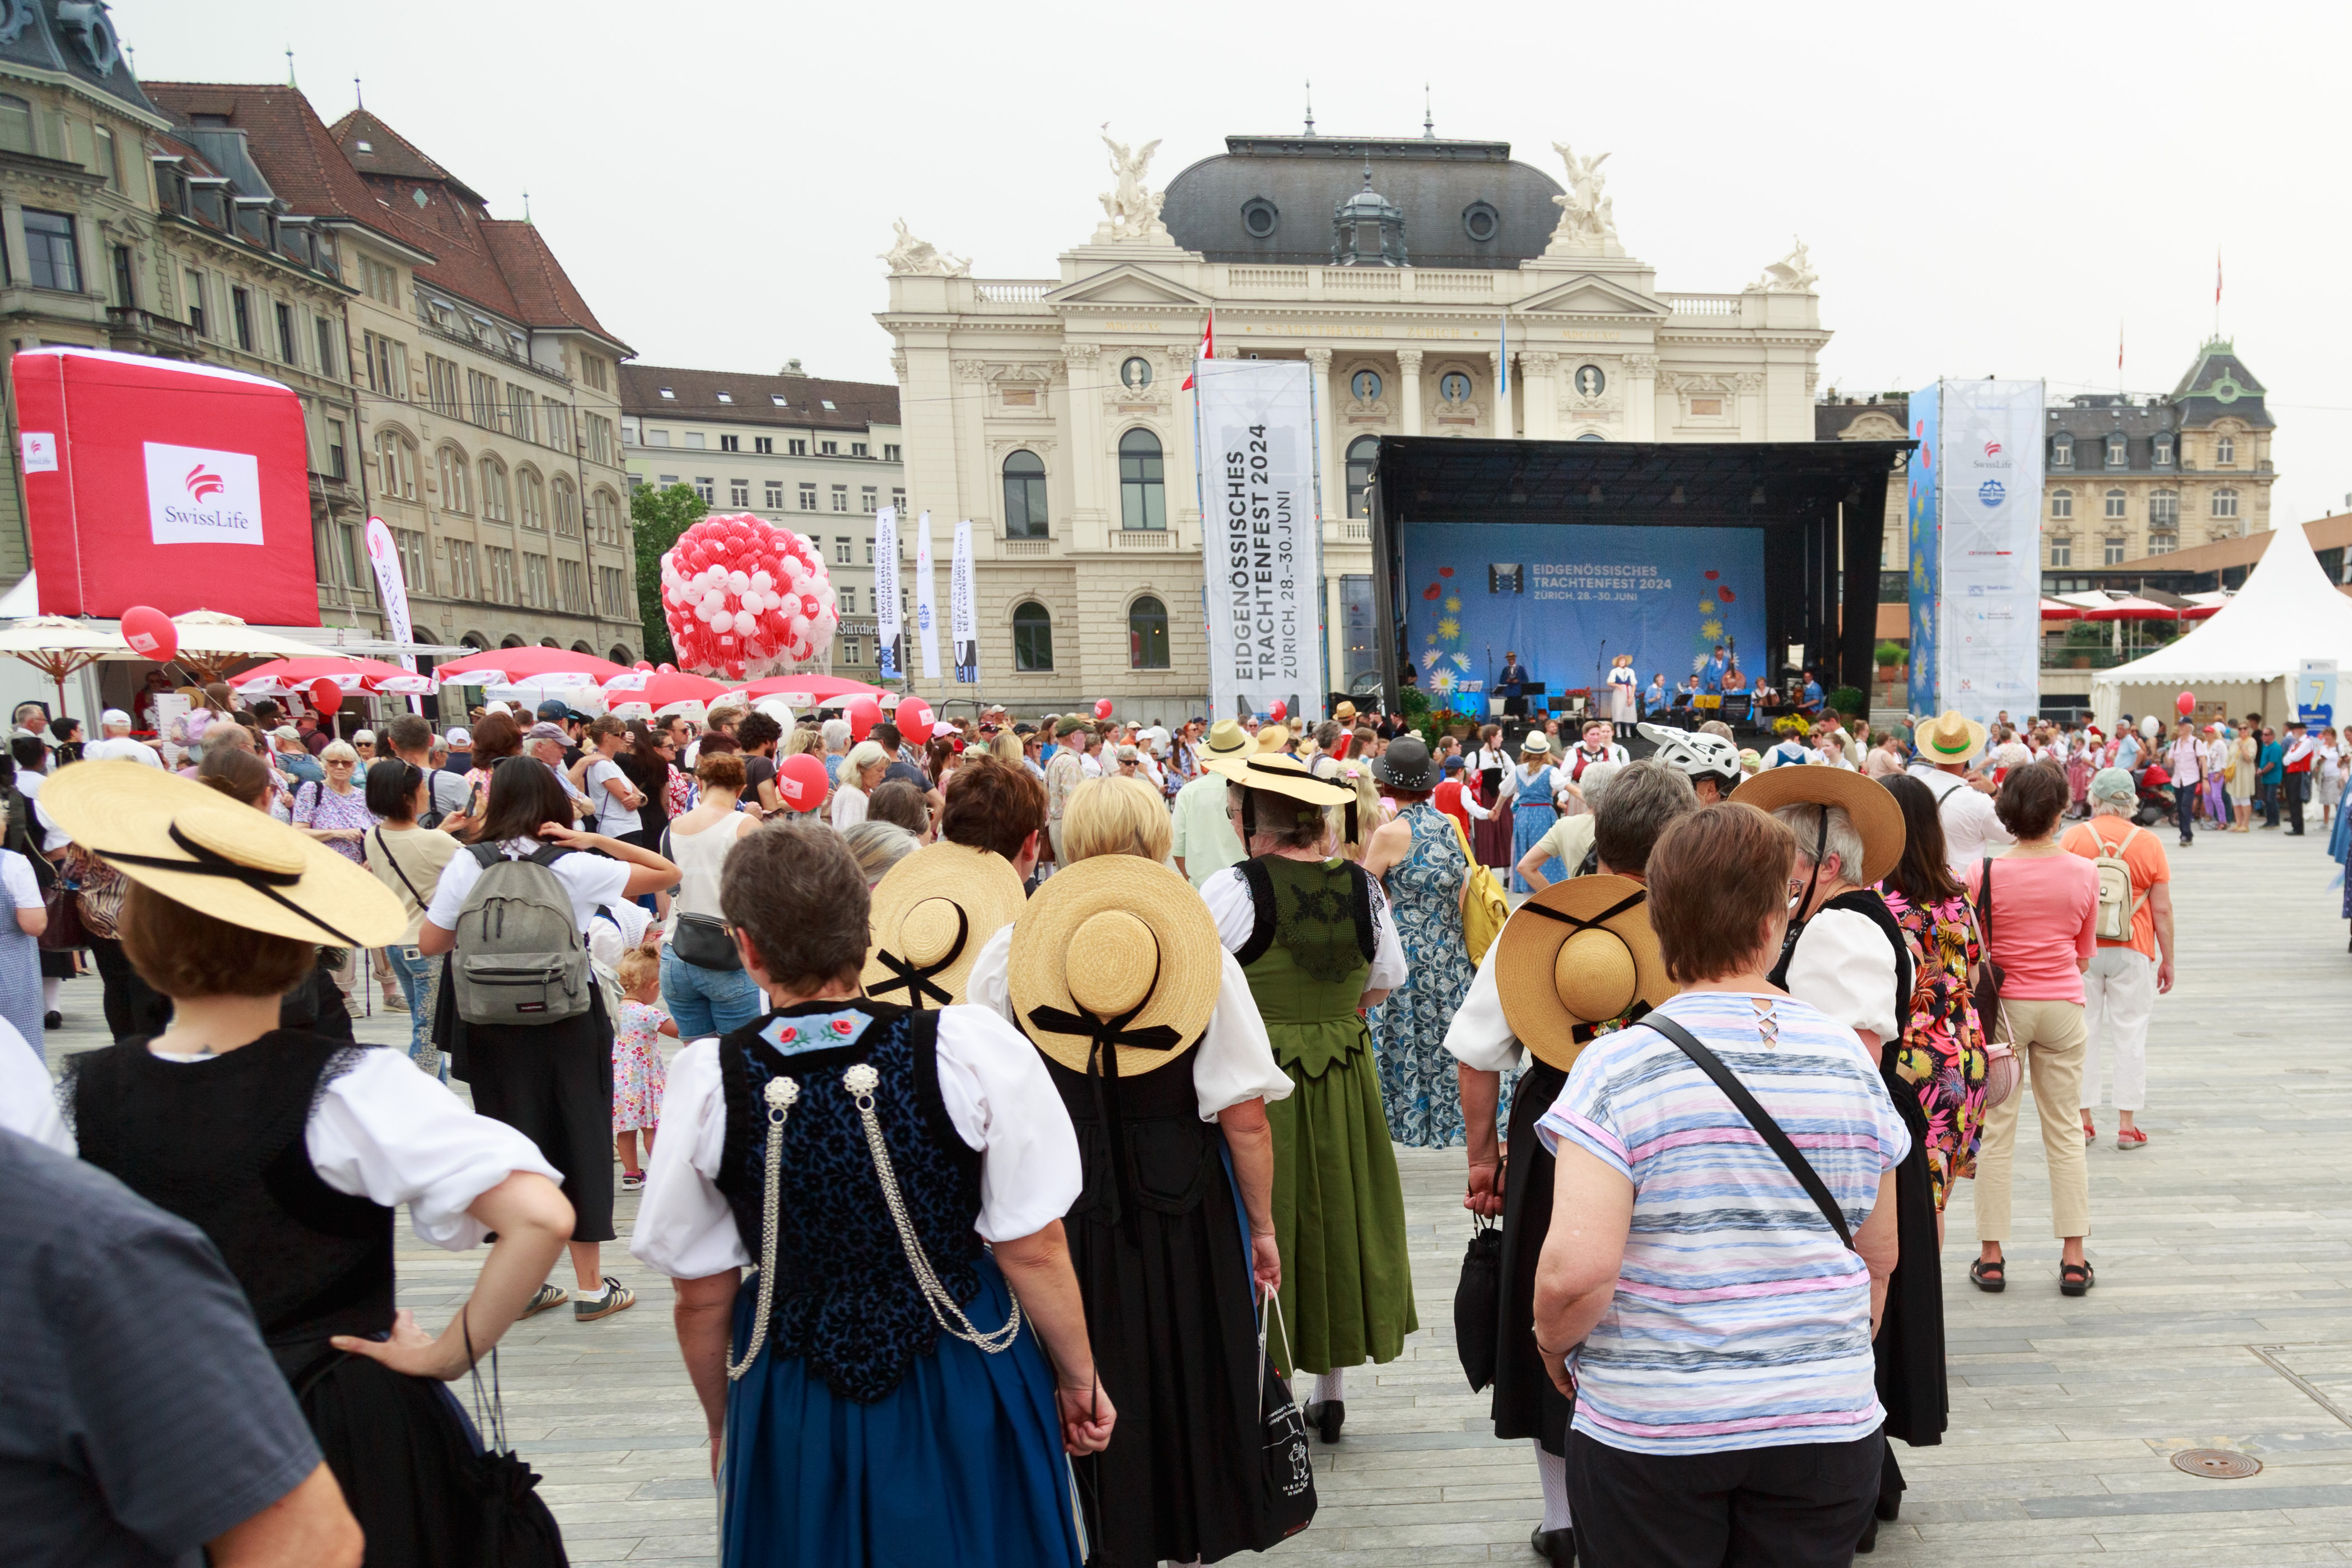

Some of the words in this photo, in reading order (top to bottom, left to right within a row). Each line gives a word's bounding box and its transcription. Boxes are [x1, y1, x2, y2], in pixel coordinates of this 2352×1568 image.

[1249, 423, 1268, 485] 2024
[1973, 460, 2012, 469] SwissLife
[166, 506, 249, 529] SwissLife
[1226, 451, 1253, 680] EIDGENÖSSISCHES
[1533, 563, 1658, 576] EIDGENÖSSISCHES
[1252, 492, 1276, 680] TRACHTENFEST
[1533, 577, 1636, 589] TRACHTENFEST
[1639, 579, 1672, 589] 2024
[1534, 591, 1576, 601] ZÜRICH,
[1281, 605, 1298, 679] ZÜRICH,
[2311, 680, 2325, 711] 7
